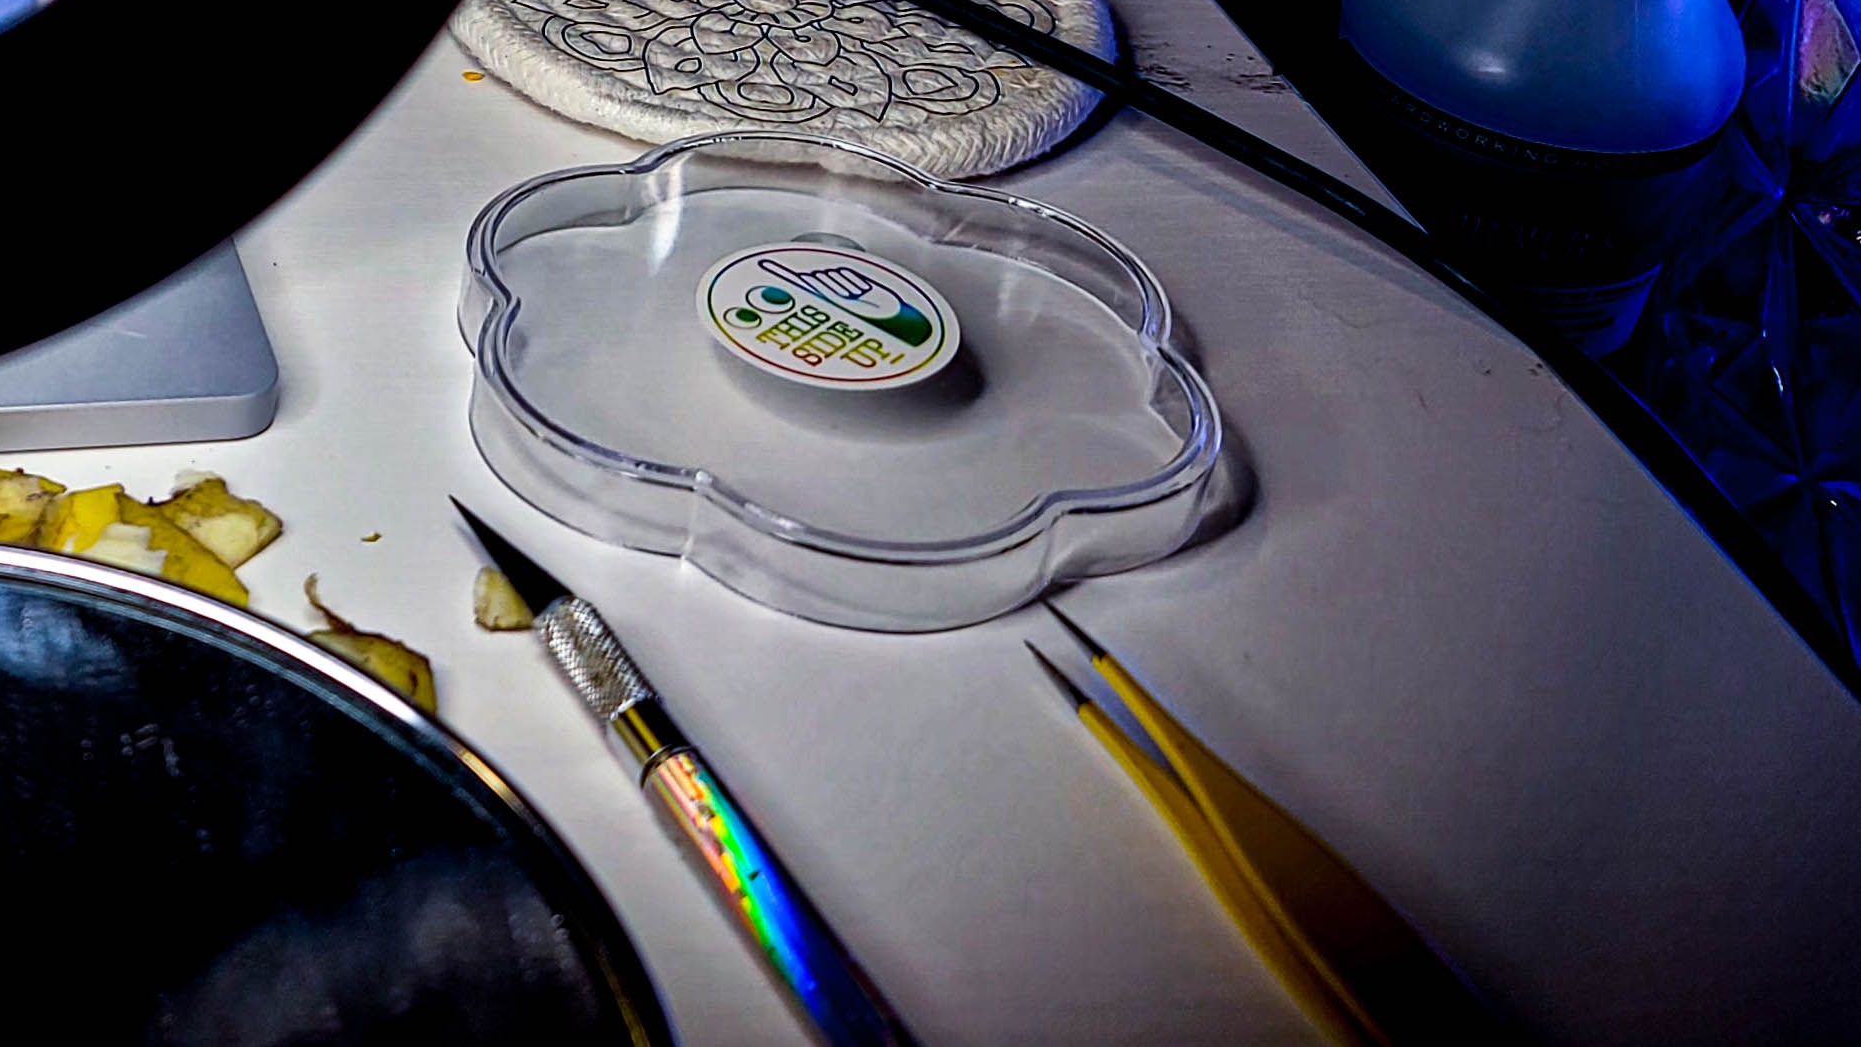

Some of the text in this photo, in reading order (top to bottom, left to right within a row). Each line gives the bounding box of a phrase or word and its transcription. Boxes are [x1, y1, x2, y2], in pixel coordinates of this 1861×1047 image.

[755, 305, 831, 351] THIS
[791, 322, 865, 367] SIDE
[840, 337, 905, 369] UP!
